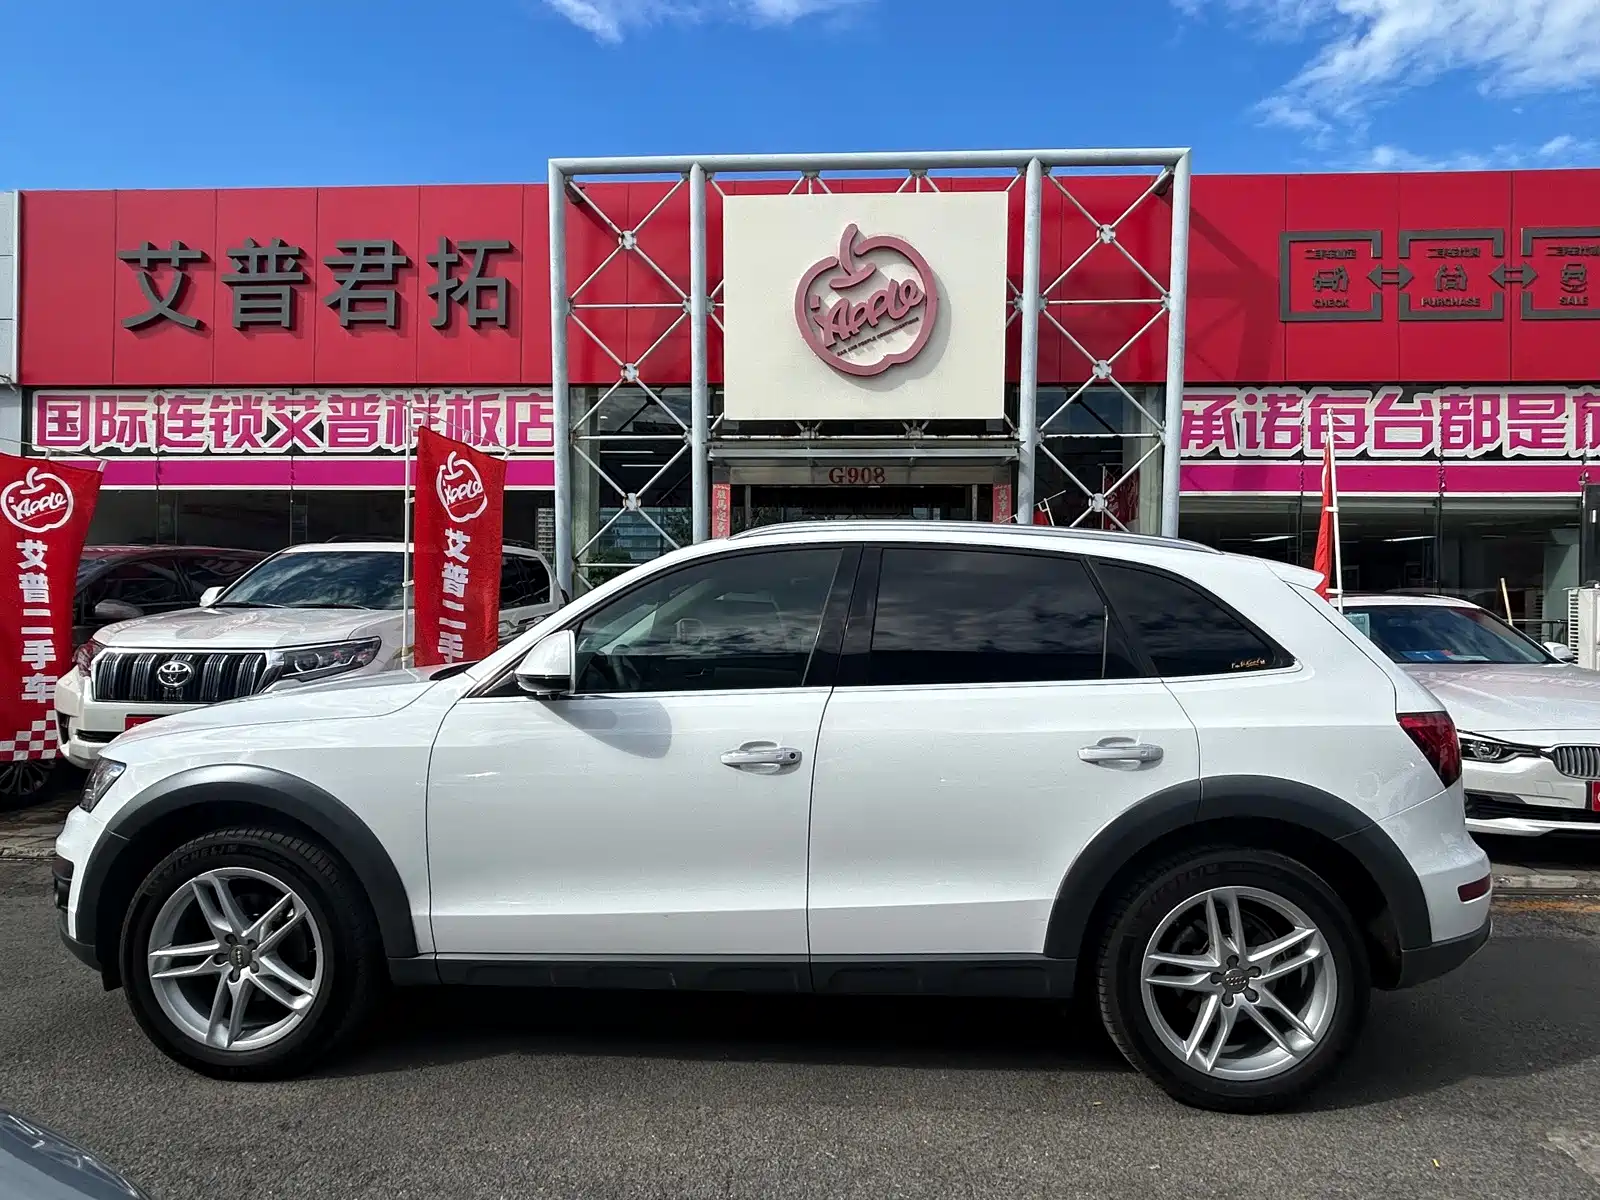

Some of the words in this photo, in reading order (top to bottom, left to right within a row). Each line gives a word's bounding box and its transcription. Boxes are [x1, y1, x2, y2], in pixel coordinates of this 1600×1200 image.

[117, 236, 512, 329] 艾普君拓
[1313, 299, 1349, 308] CHECK
[1421, 297, 1481, 307] PURCHASE
[1559, 296, 1589, 306] SALE
[36, 393, 555, 449] 国际连锁艾普样板店
[829, 467, 886, 484] G908
[16, 539, 58, 704] 艾普二手车
